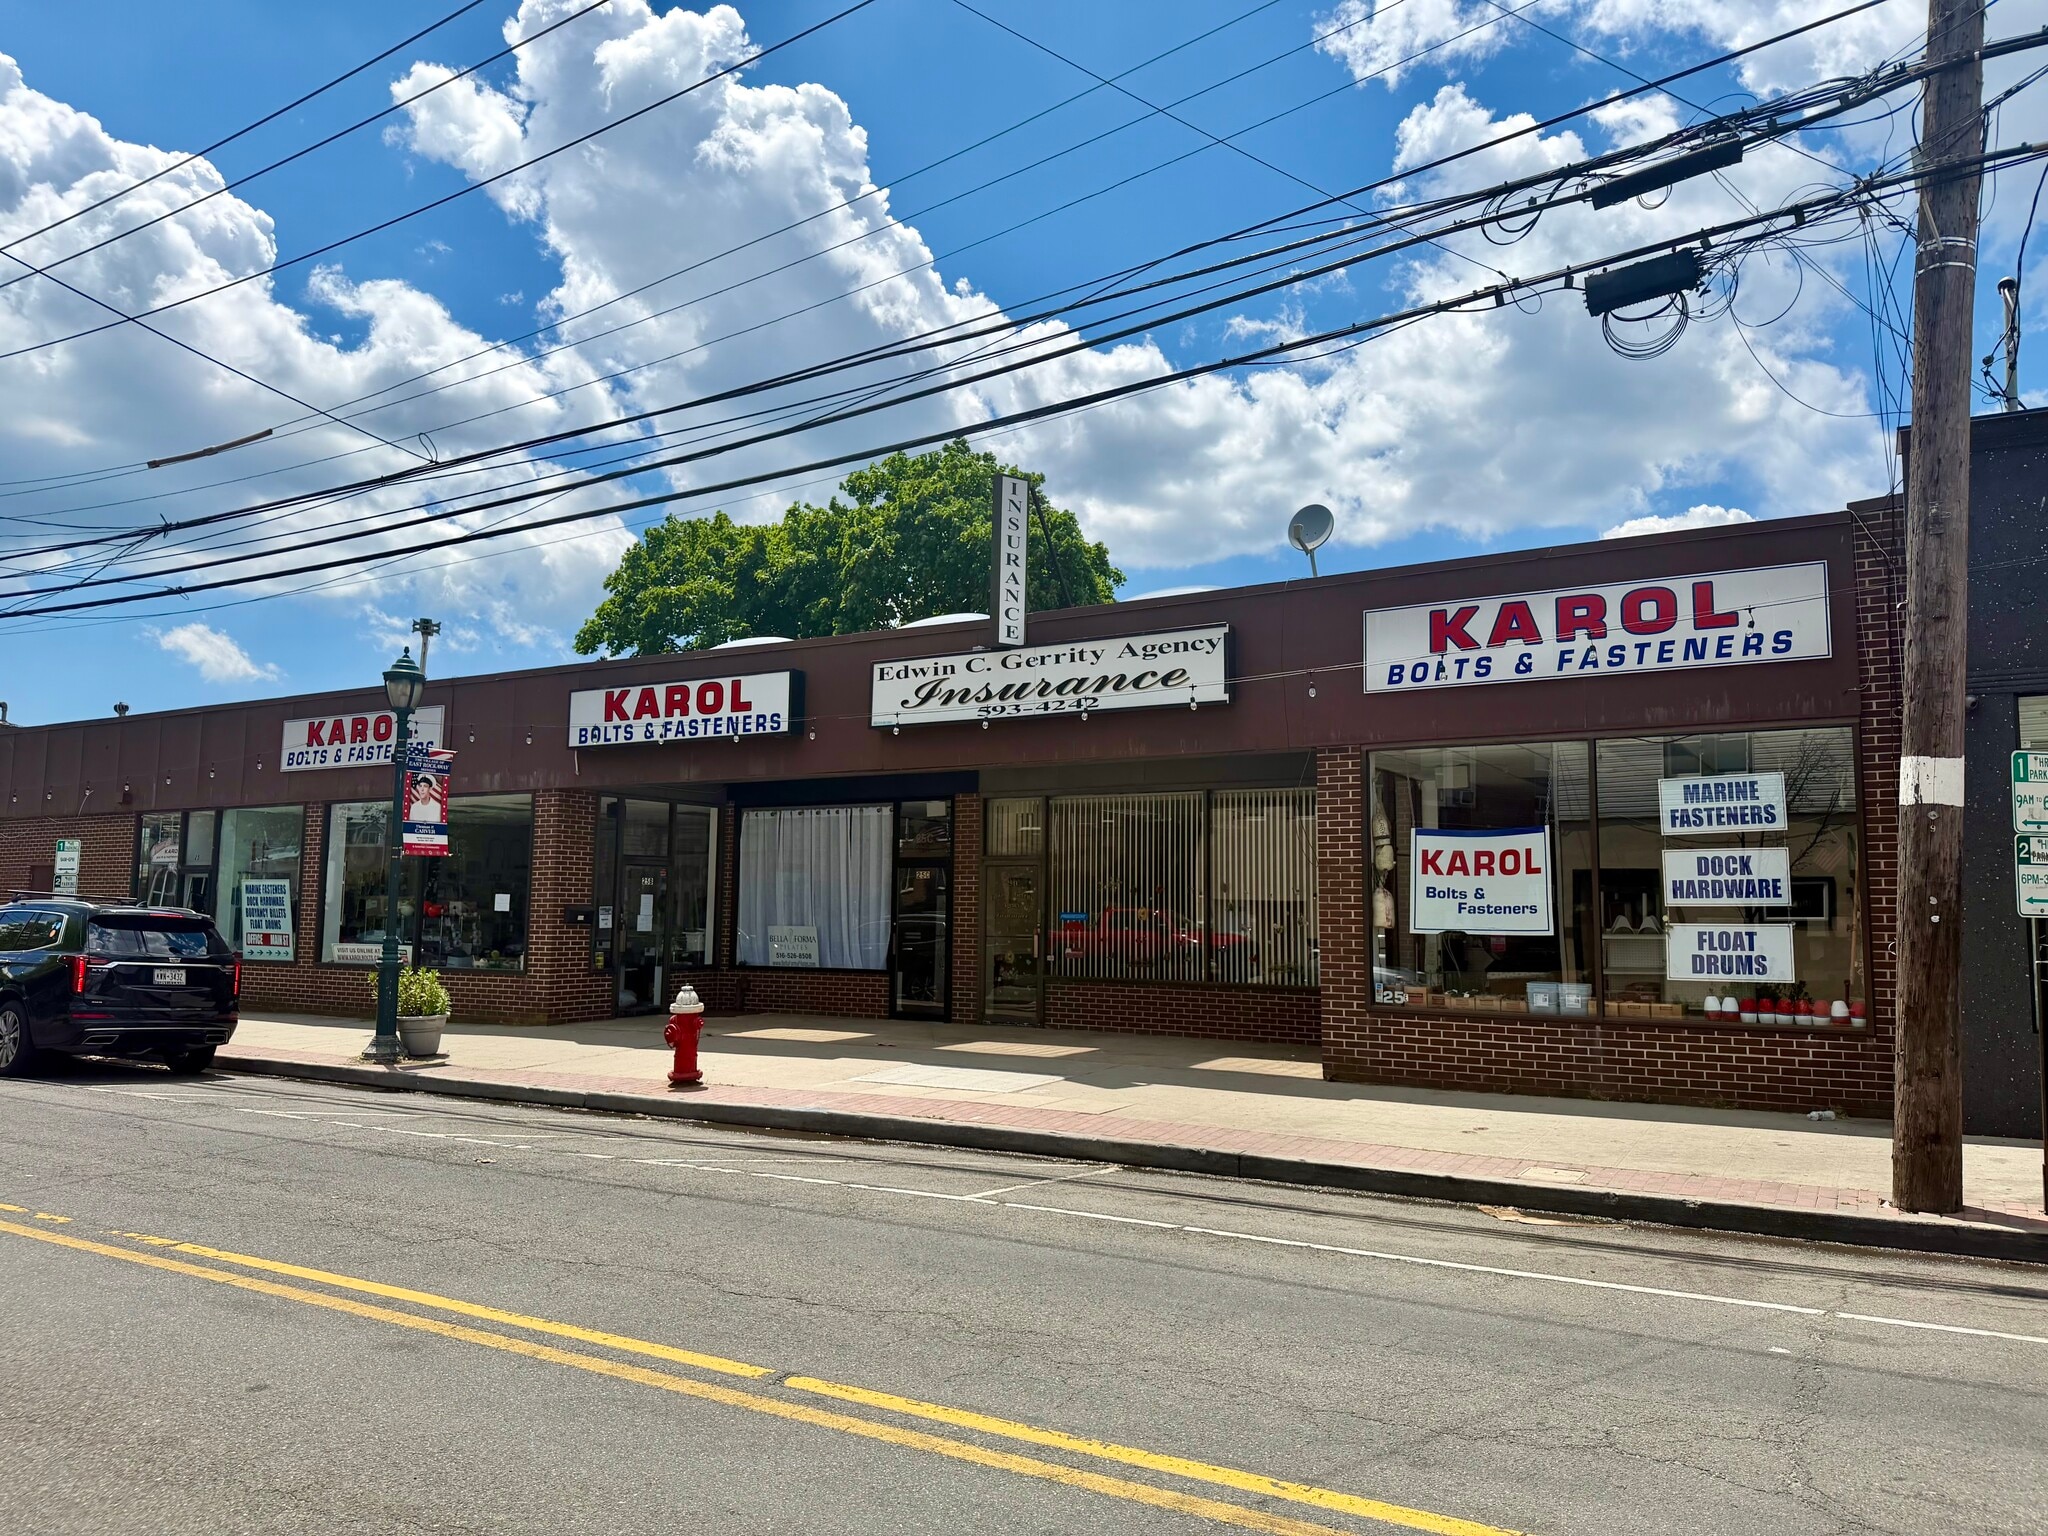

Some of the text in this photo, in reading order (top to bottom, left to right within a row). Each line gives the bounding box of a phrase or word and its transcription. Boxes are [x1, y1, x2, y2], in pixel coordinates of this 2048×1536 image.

[1004, 482, 1022, 640] INSURANCE
[1429, 580, 1740, 654] KAROL
[876, 636, 1221, 682] Edwin C. Gerrity Agency
[1514, 653, 1534, 674] &
[1557, 629, 1794, 671] FASTENERS
[900, 667, 1191, 710] Insurance
[603, 679, 753, 722] KAROL
[976, 697, 1100, 717] 593-4242
[306, 714, 412, 747] KARO
[578, 713, 782, 744] BOLTS & FASTENERS
[287, 749, 328, 766] BOLTS
[333, 749, 342, 763] &
[2017, 757, 2024, 778] 1
[1683, 781, 1760, 804] MARINE
[2016, 794, 2035, 808] 9AM
[1670, 804, 1777, 828] FASTENERS
[59, 842, 64, 850] 1
[2018, 842, 2030, 858] 2
[1421, 848, 1541, 876] KAROL
[1696, 855, 1753, 876] DOCK
[245, 884, 287, 895] MARINE FASTENERS
[1426, 887, 1485, 899] Bolts &
[1672, 879, 1782, 899] HARDWARE
[247, 896, 284, 906] DOCK HARDWARE
[1458, 902, 1538, 914] Fasteners
[250, 919, 281, 930] FLOAT DRUMS
[247, 933, 290, 946] OFFICE MAIN ST
[769, 935, 816, 943] BELLA FORMA
[1697, 931, 1757, 952] FLOAT
[1691, 954, 1768, 975] DRUMS
